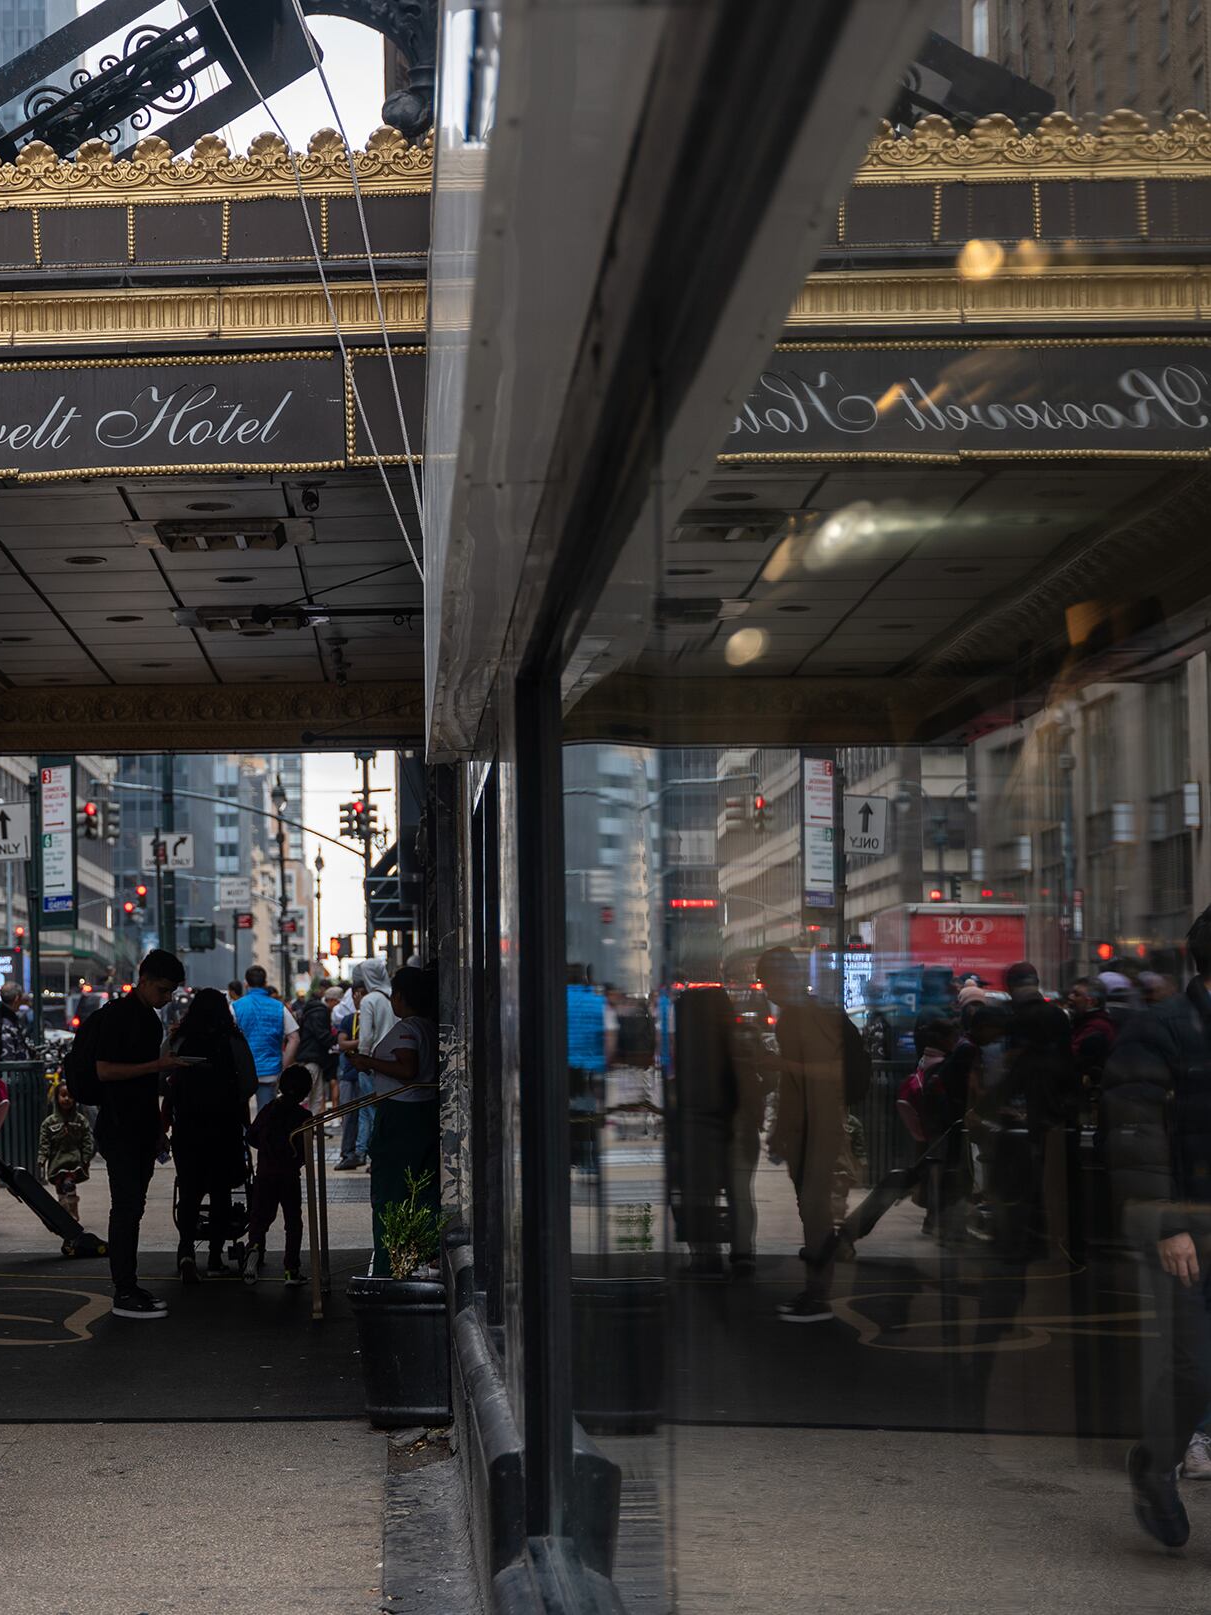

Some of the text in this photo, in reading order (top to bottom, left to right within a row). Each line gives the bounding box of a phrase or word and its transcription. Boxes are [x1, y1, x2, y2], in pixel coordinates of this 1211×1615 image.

[95, 383, 293, 450] Hotel
[44, 770, 50, 783] 3
[45, 834, 51, 847] 6
